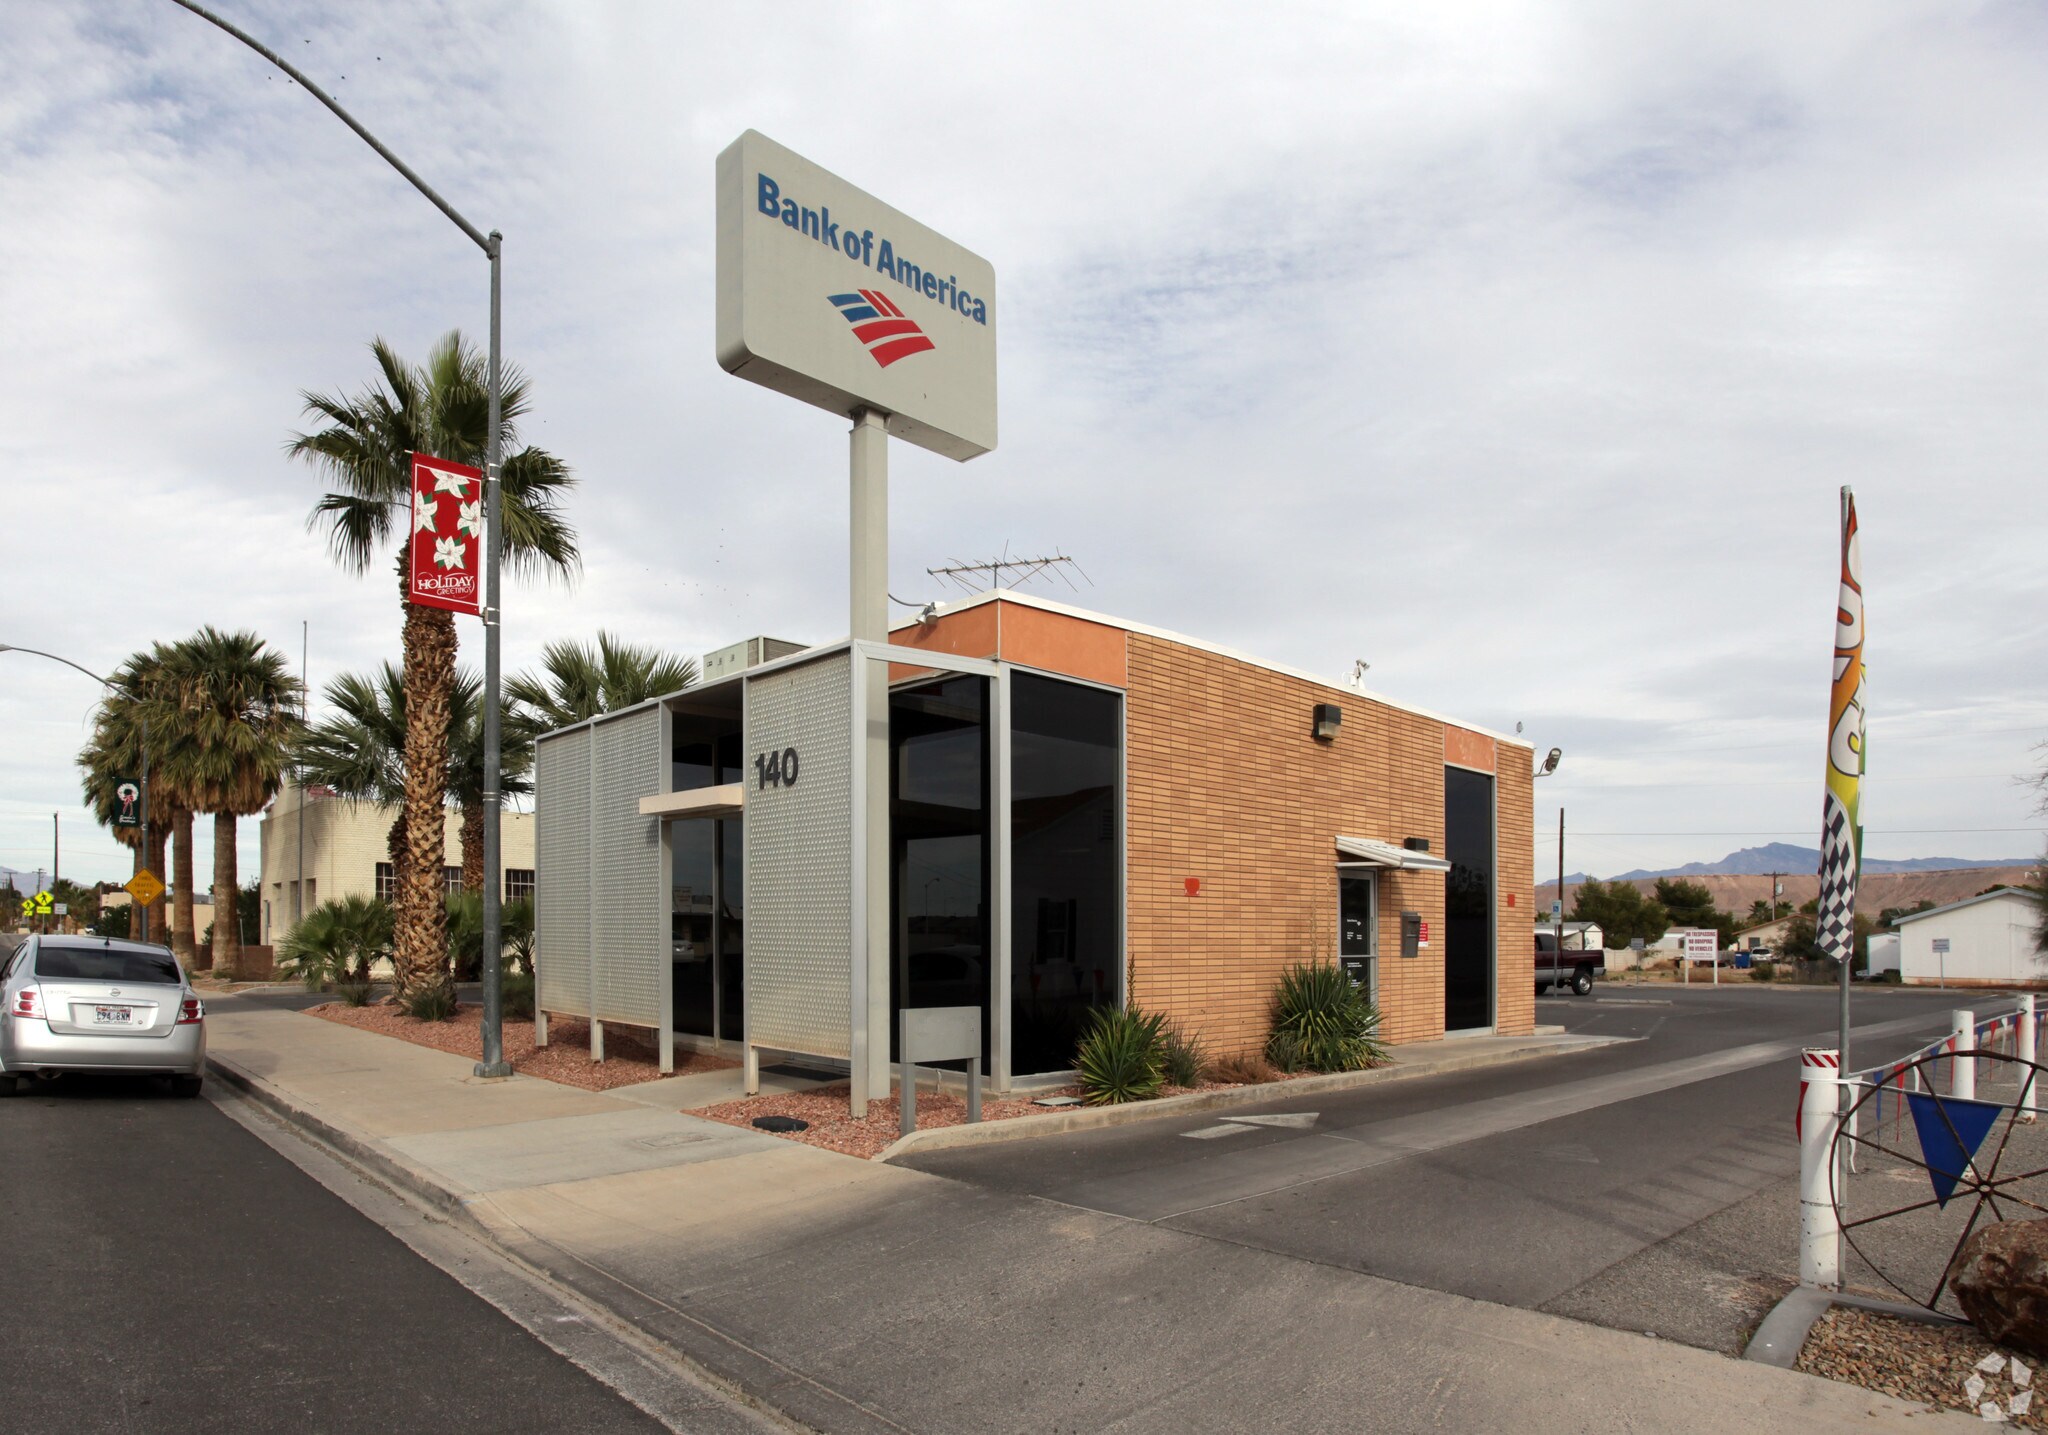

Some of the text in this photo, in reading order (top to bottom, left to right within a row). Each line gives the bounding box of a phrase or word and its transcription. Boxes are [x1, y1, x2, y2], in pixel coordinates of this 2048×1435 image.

[757, 172, 987, 326] Bank of America
[417, 574, 474, 590] HOLIDAY
[436, 586, 473, 595] GREETINGS
[755, 747, 799, 790] 140
